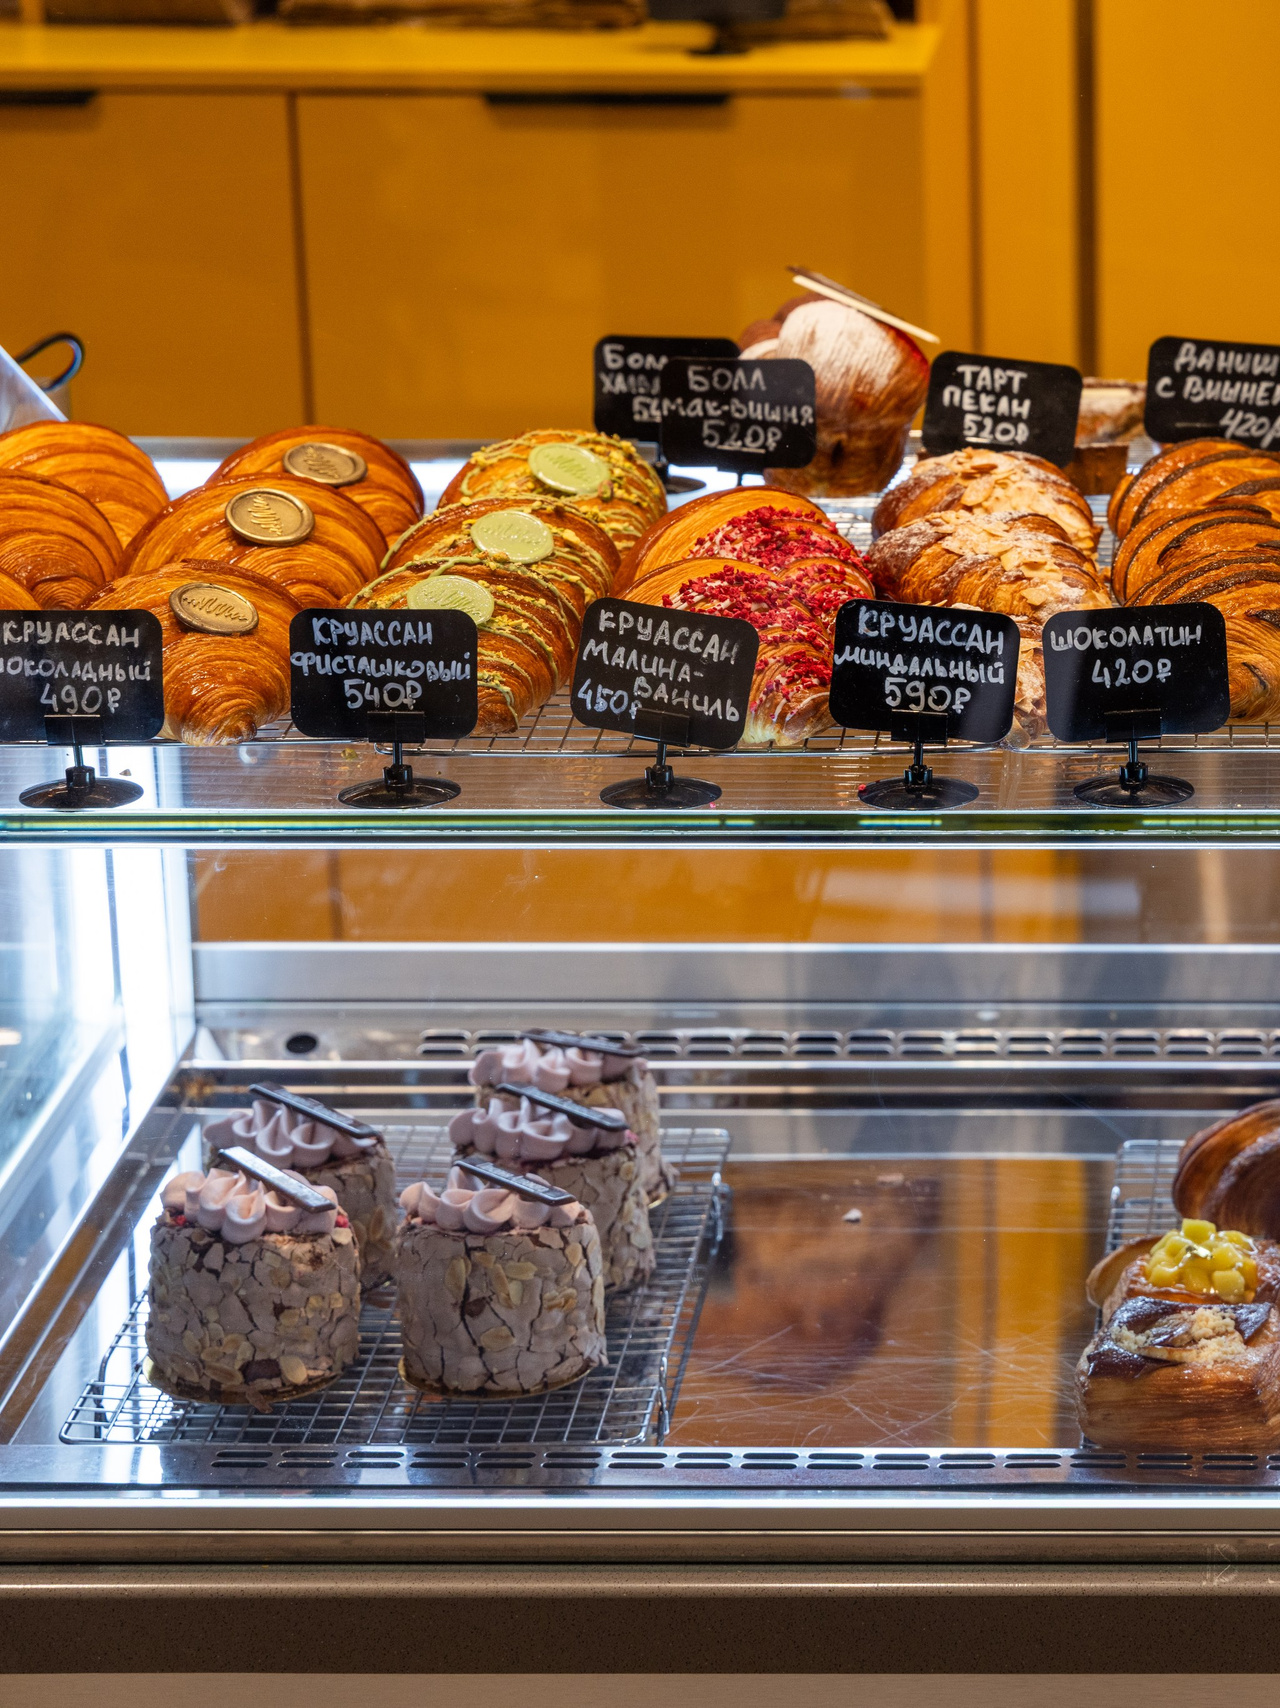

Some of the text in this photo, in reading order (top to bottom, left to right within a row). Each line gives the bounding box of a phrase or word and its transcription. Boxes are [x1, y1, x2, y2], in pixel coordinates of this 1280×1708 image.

[1174, 342, 1280, 377] ДАНИШ
[956, 364, 1028, 394] ТАРТ
[942, 385, 1031, 420] ПЕКАН
[3, 620, 140, 648] КРУАССАН
[312, 617, 433, 647] КРУАССАН
[599, 609, 740, 664] КРУАССАН
[858, 605, 1004, 655] КРУАССАН
[1050, 624, 1202, 651] ШОКОЛАТИН
[0, 656, 151, 682] ОКОЛАДНЫЙ
[290, 652, 471, 682] ФИСТАШКОВЫЙ
[633, 676, 740, 722] ВАНИЛЬ
